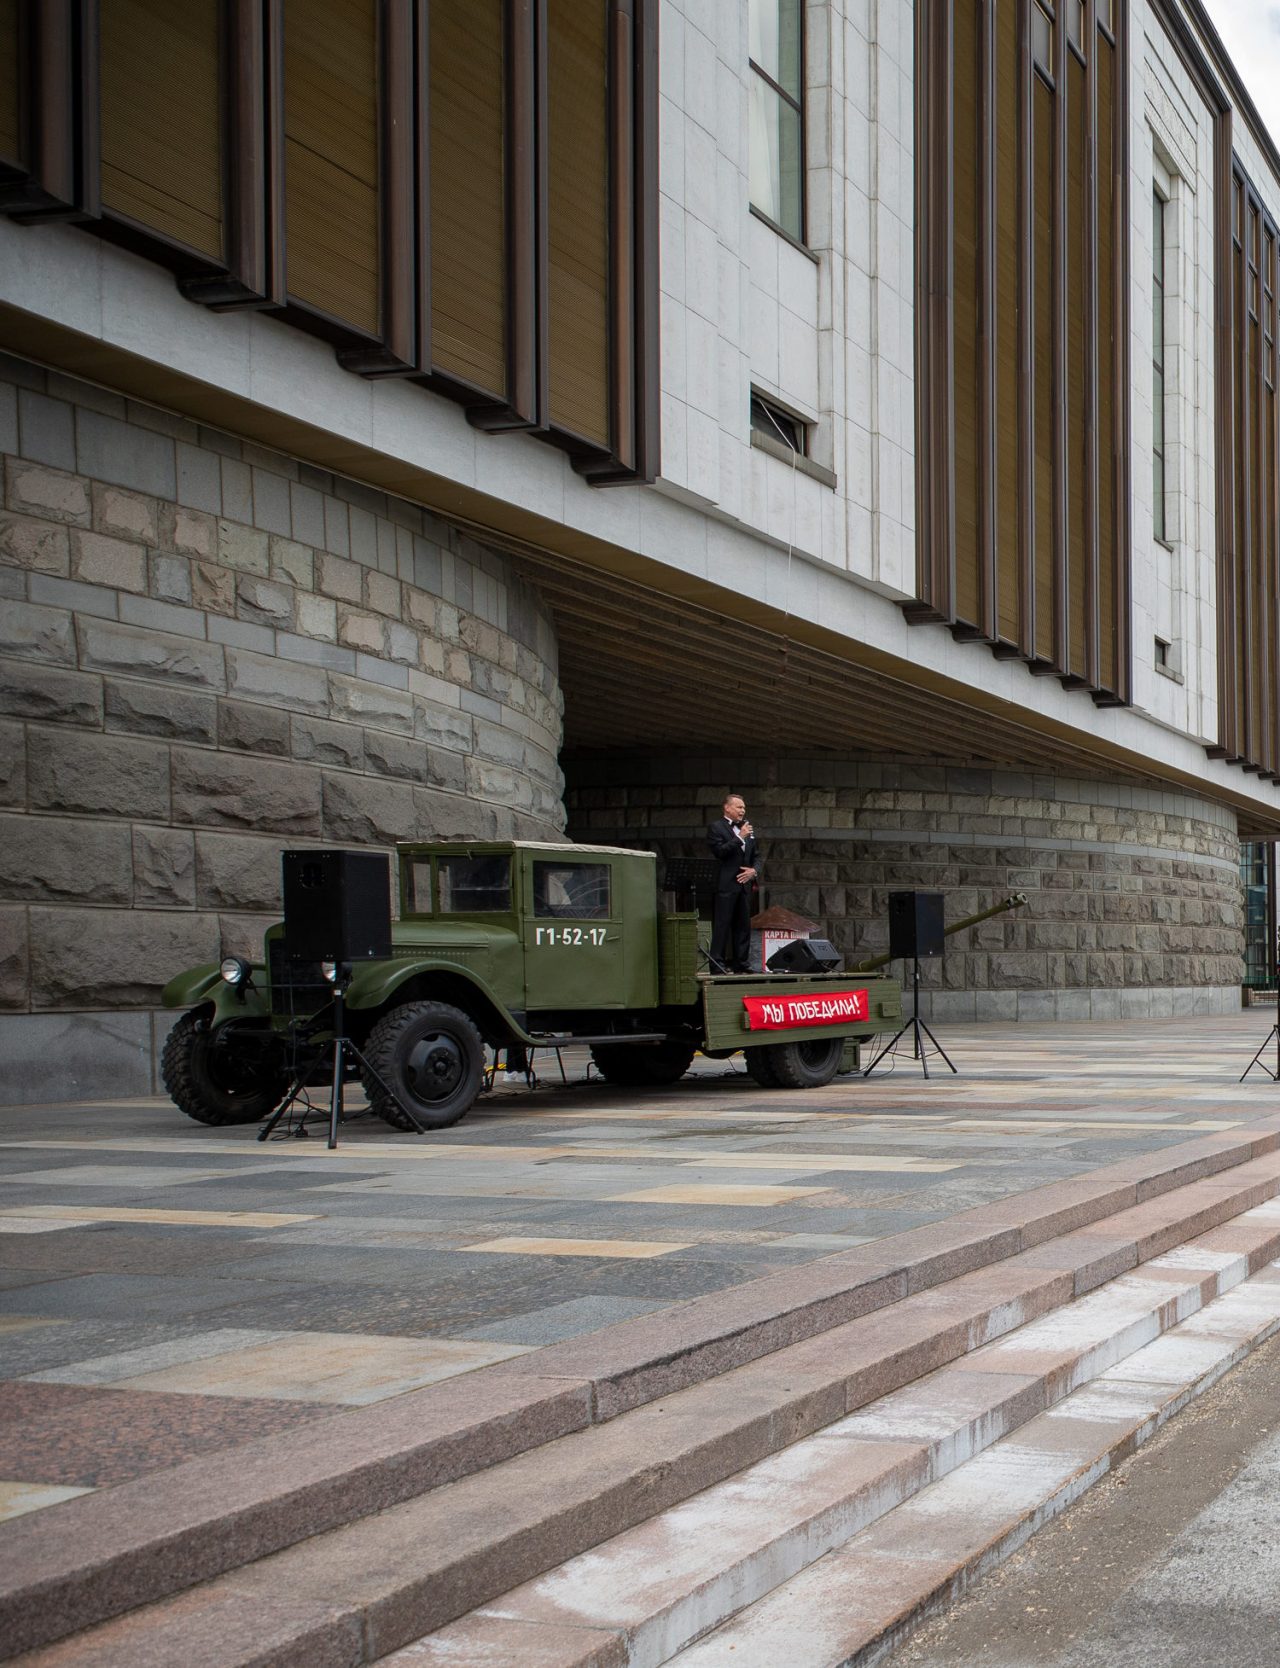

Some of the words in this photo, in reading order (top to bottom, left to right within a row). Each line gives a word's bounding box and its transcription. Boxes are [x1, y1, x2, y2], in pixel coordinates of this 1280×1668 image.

[536, 927, 606, 946] Г1-52-17
[765, 930, 789, 939] КАРТА
[762, 1003, 784, 1023] МЫ
[788, 994, 860, 1021] ПОБЕДИЛИ!
